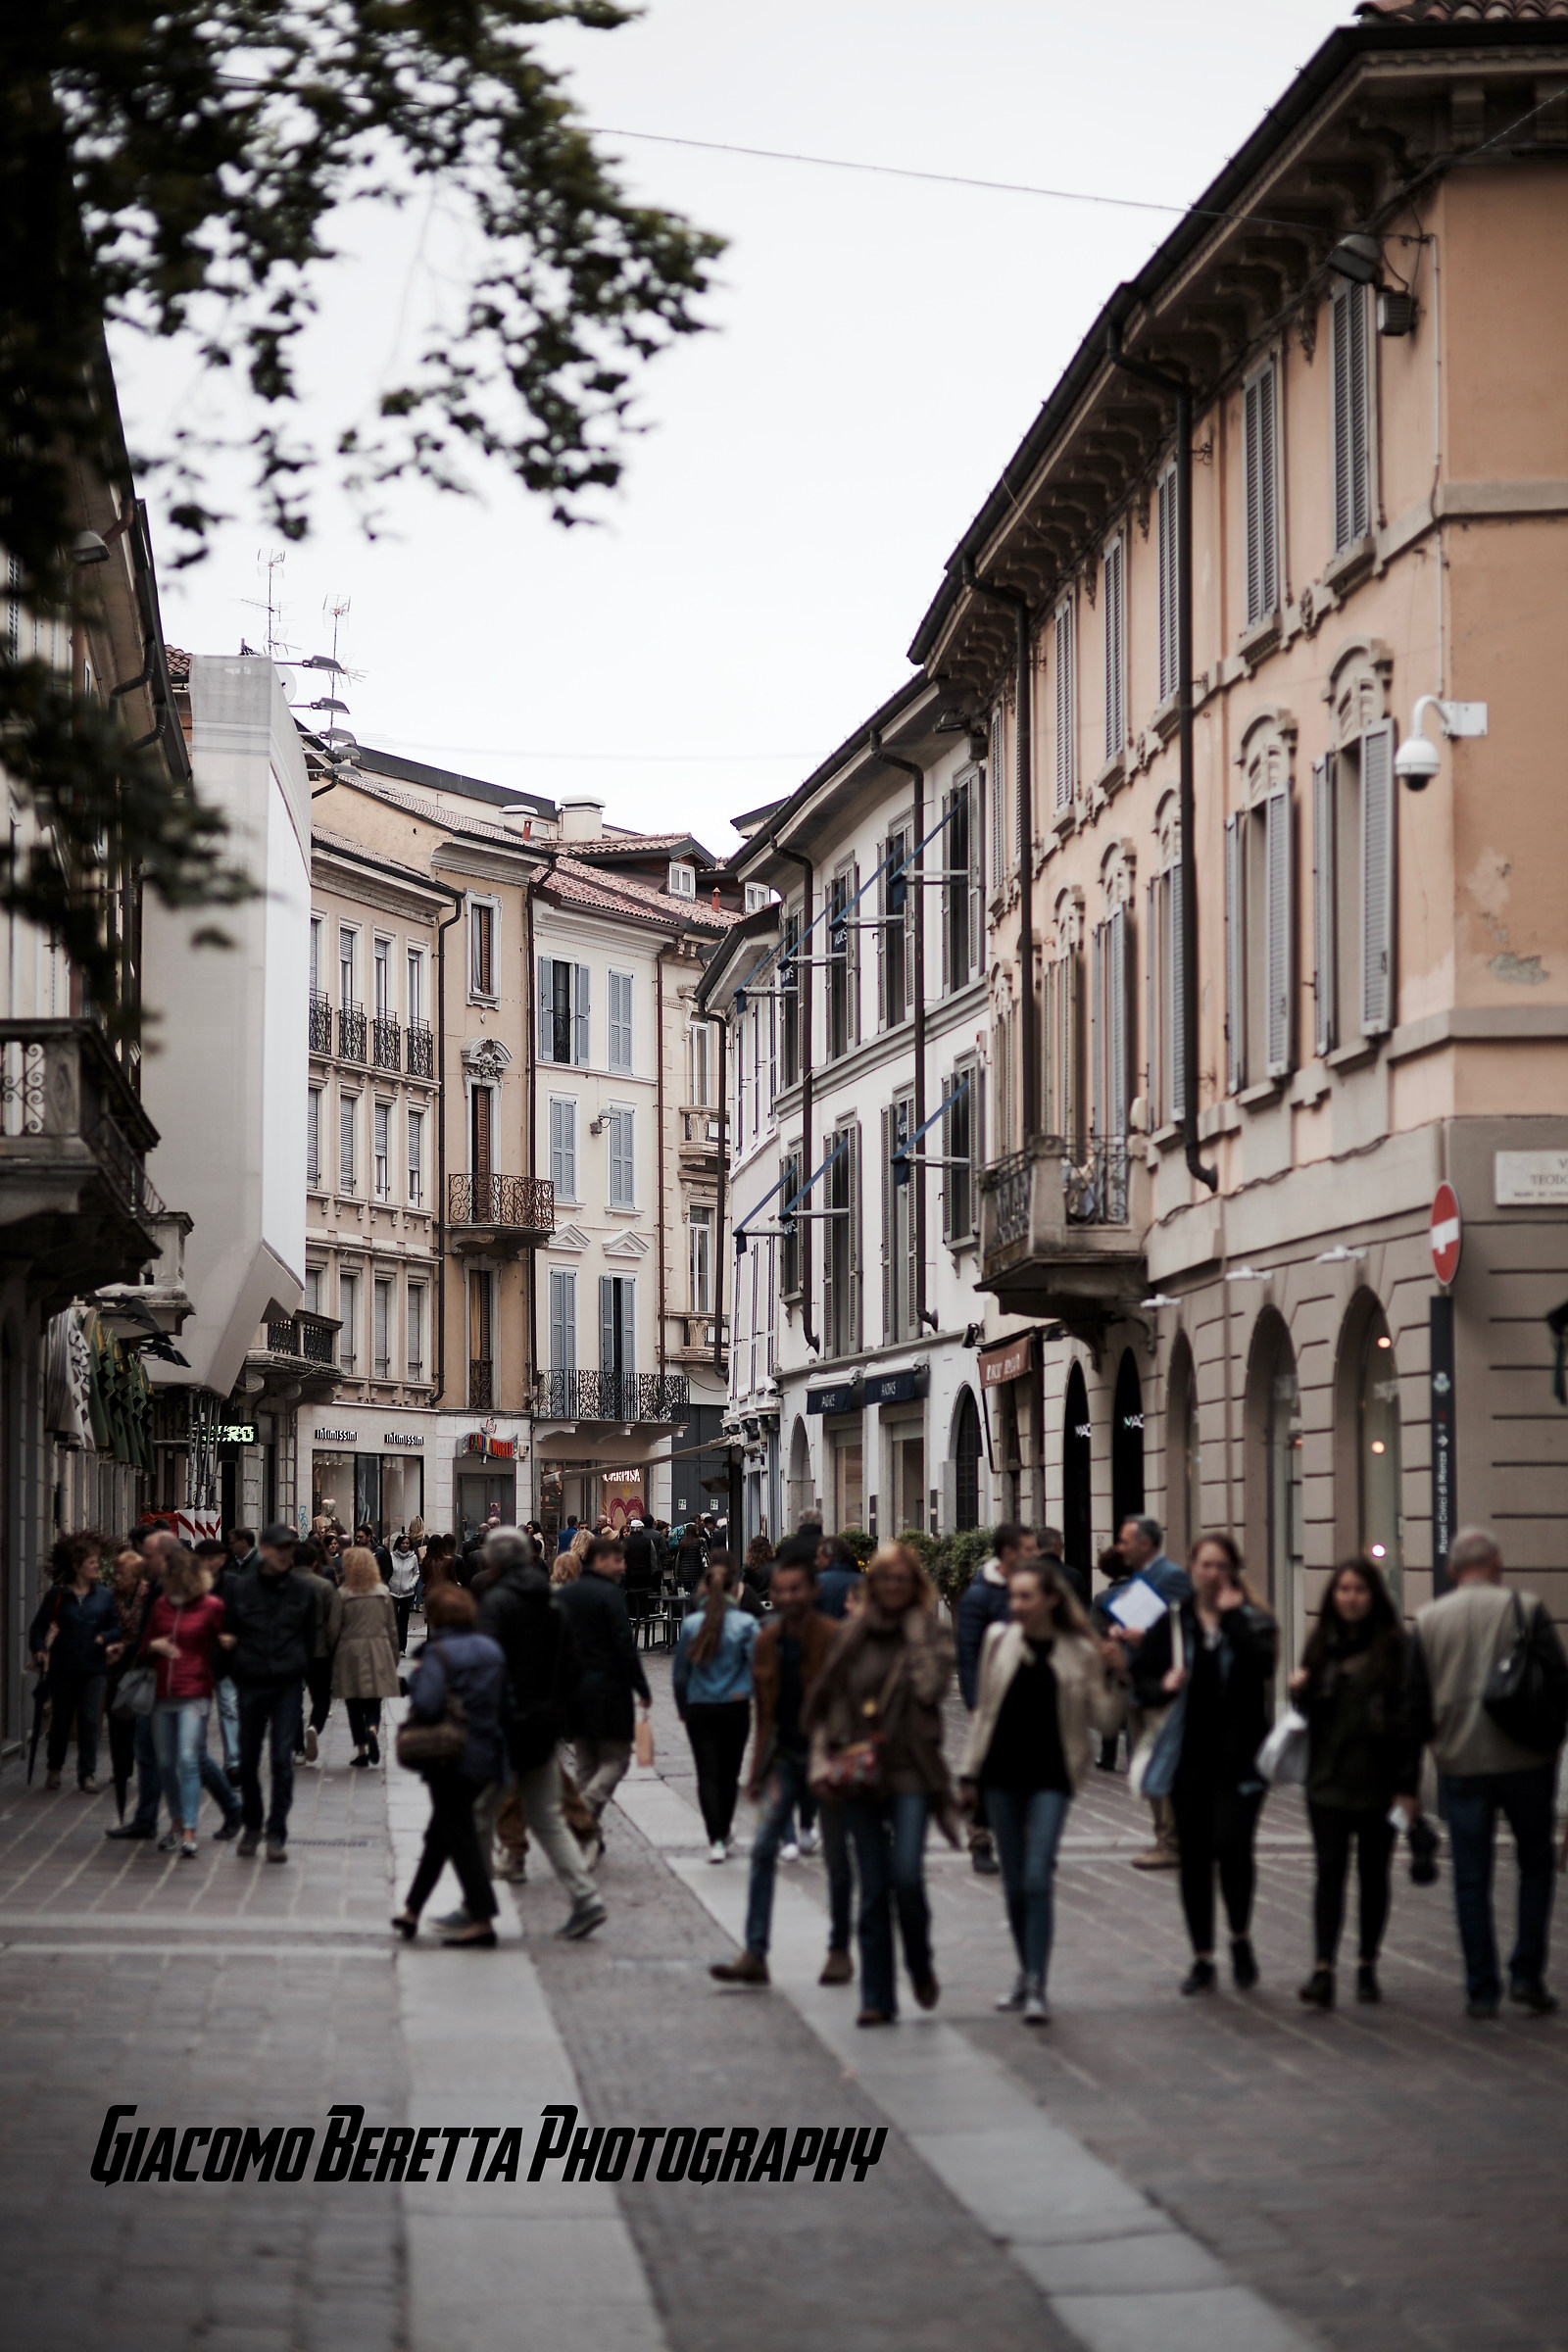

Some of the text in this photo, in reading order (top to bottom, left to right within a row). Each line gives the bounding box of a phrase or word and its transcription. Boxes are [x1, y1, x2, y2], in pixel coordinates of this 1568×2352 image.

[469, 1435, 512, 1457] CANDY WORLD
[1438, 1451, 1447, 1483] Monza
[1438, 1485, 1447, 1494] di
[1439, 1496, 1447, 1522] Civici
